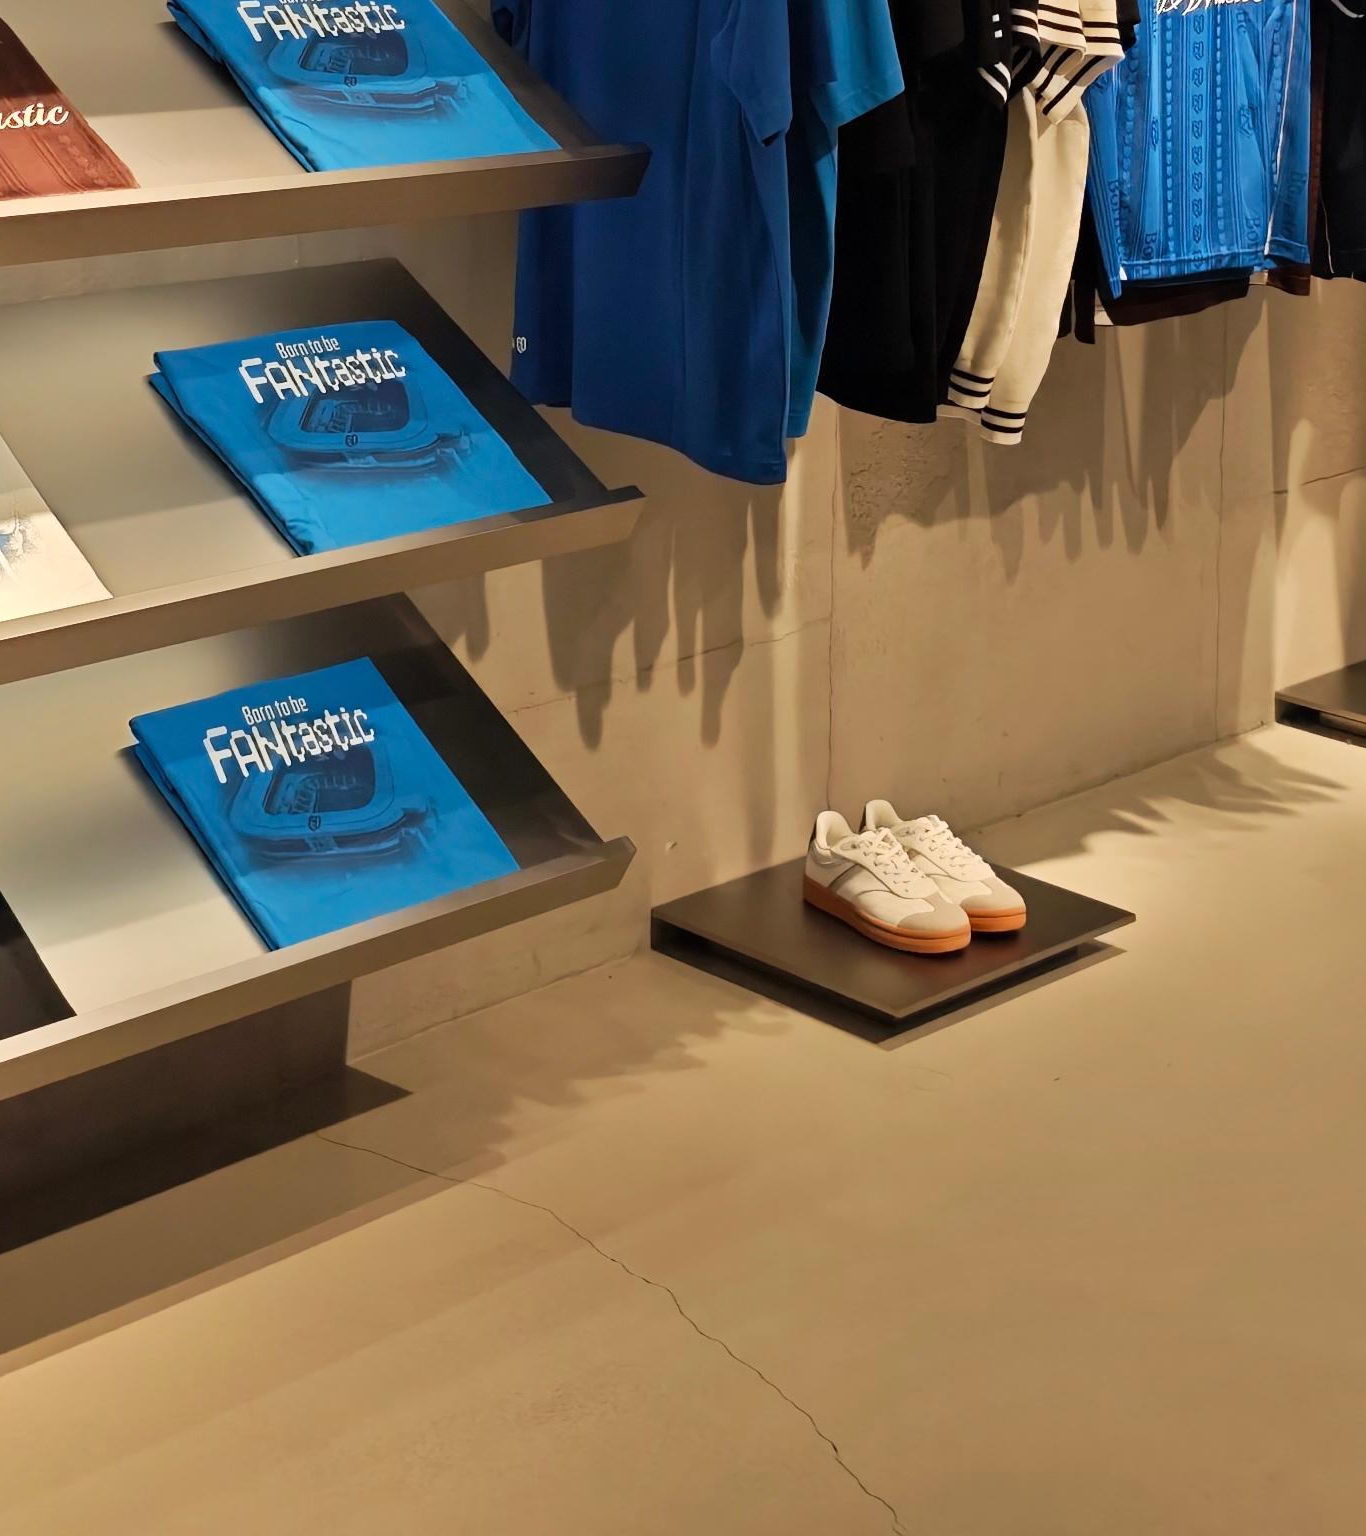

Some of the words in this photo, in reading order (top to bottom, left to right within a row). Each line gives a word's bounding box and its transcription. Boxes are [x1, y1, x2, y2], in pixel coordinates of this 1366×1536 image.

[237, 0, 406, 42] FANtastic
[275, 341, 308, 361] Born
[307, 338, 323, 355] to
[322, 335, 341, 353] be
[238, 346, 407, 404] FANtastic
[241, 704, 276, 727] Born
[274, 699, 290, 718] to
[289, 695, 309, 714] be
[203, 706, 376, 784] FANtastic
